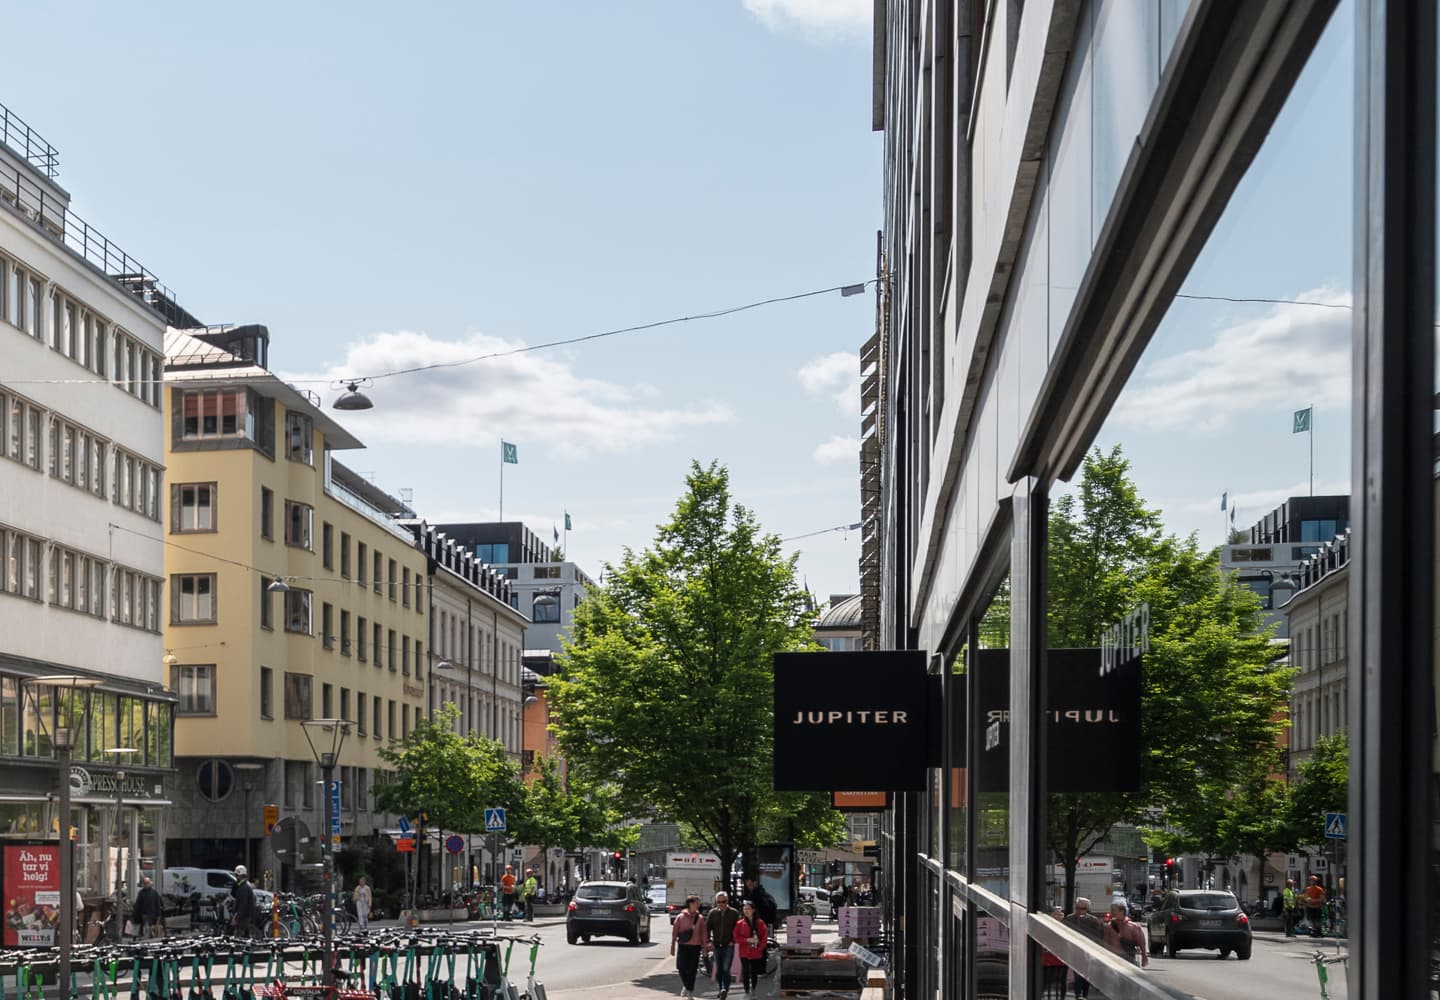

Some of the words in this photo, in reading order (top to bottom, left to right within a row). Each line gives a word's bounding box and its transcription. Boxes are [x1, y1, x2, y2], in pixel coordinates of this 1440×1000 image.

[1099, 602, 1150, 677] JUPITER
[792, 710, 908, 725] JUPITER
[19, 850, 37, 862] Äh,
[39, 853, 53, 862] nu
[22, 863, 37, 871] tar
[39, 861, 49, 871] vi
[23, 871, 48, 882] helg!
